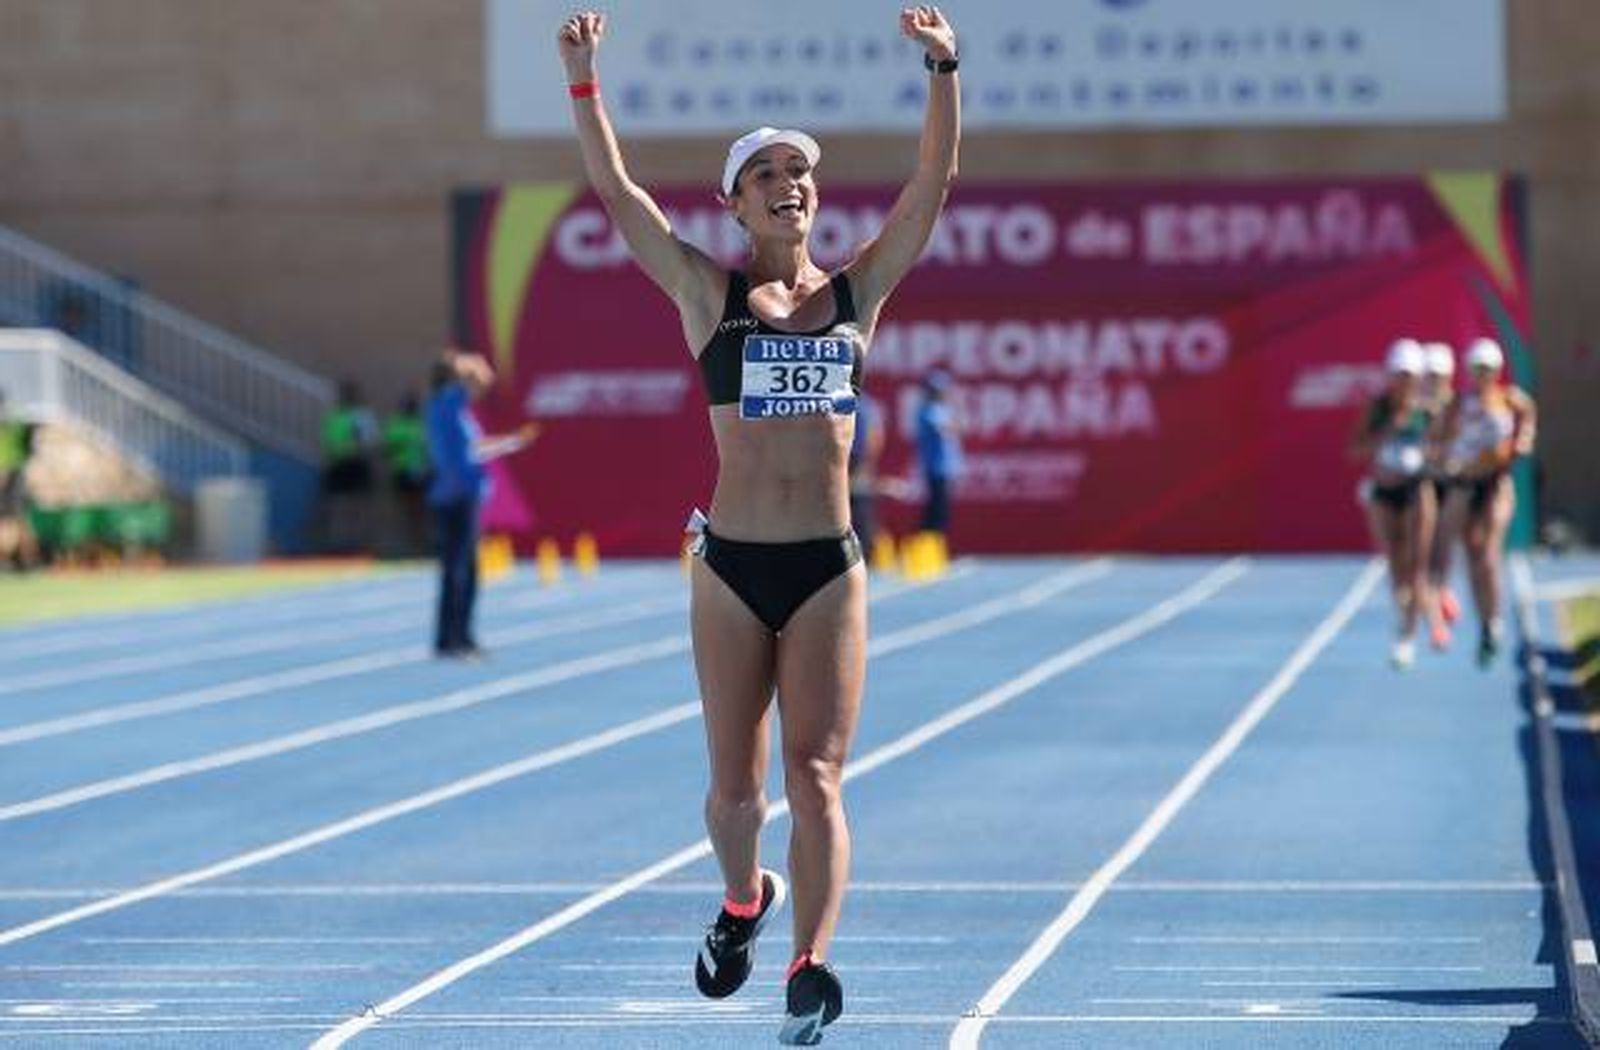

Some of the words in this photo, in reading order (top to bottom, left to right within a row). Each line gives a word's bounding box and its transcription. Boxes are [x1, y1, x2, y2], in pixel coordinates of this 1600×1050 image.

[895, 75, 1381, 110] Auntamiento
[555, 208, 1056, 267] CMPOATO
[1143, 196, 1416, 263] ESPAÑA
[862, 322, 1228, 375] MPEONATO
[769, 366, 829, 394] 362
